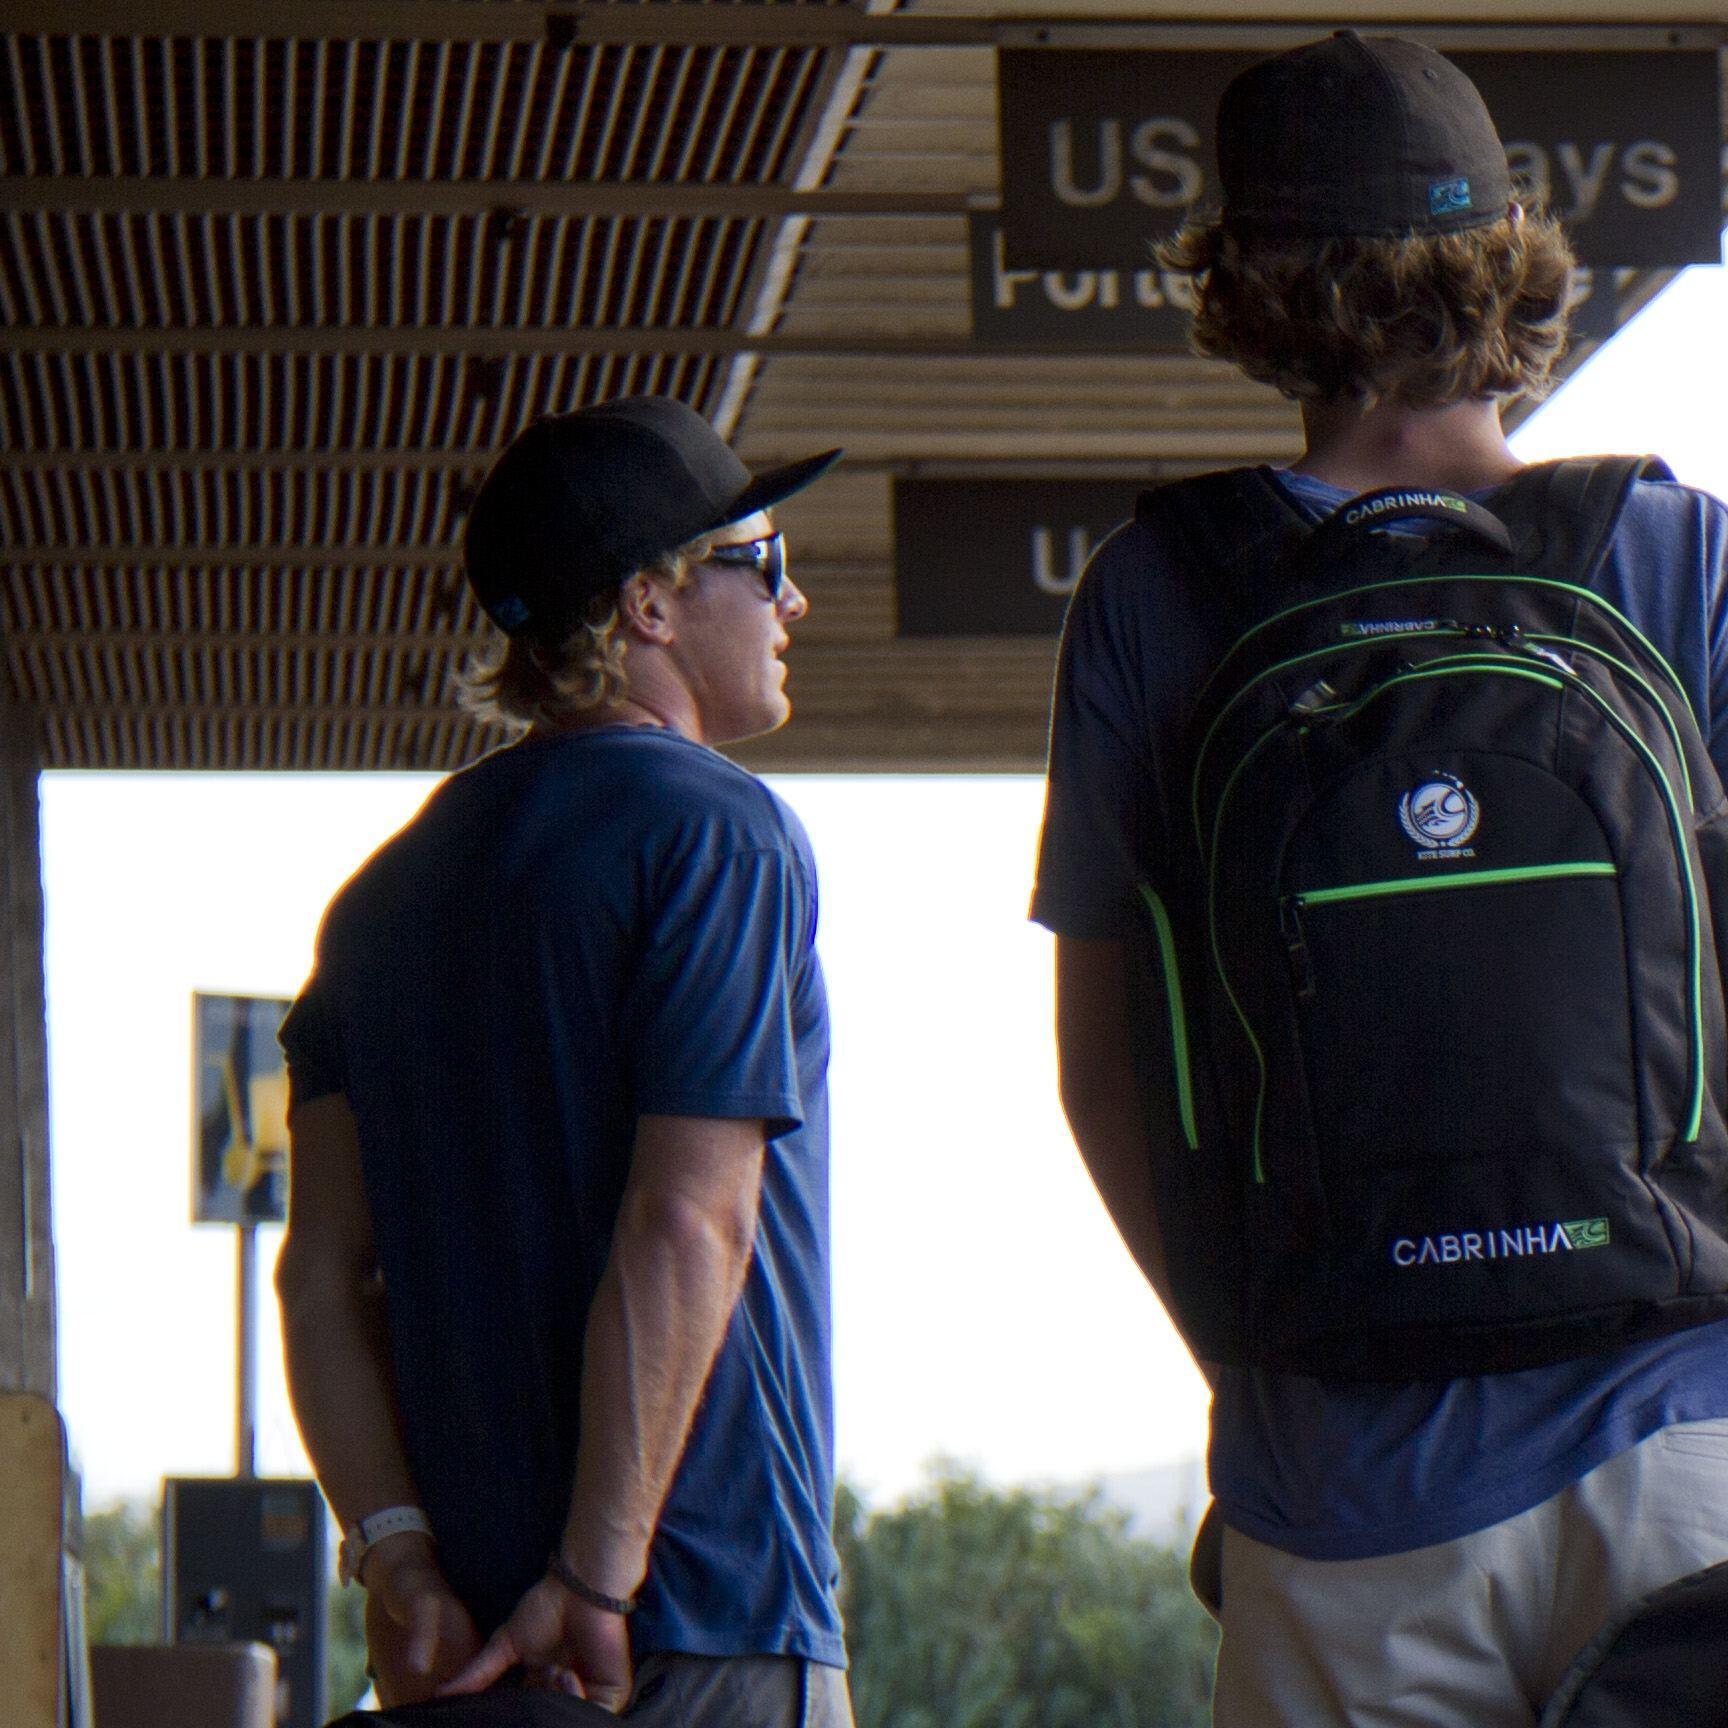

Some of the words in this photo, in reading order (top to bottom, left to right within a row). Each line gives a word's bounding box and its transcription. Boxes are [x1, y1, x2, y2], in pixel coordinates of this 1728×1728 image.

[1051, 117, 1202, 207] US
[1346, 493, 1447, 525] CABRINHA
[1359, 620, 1436, 635] CABRINHA
[1393, 1223, 1573, 1266] CABRINHA
